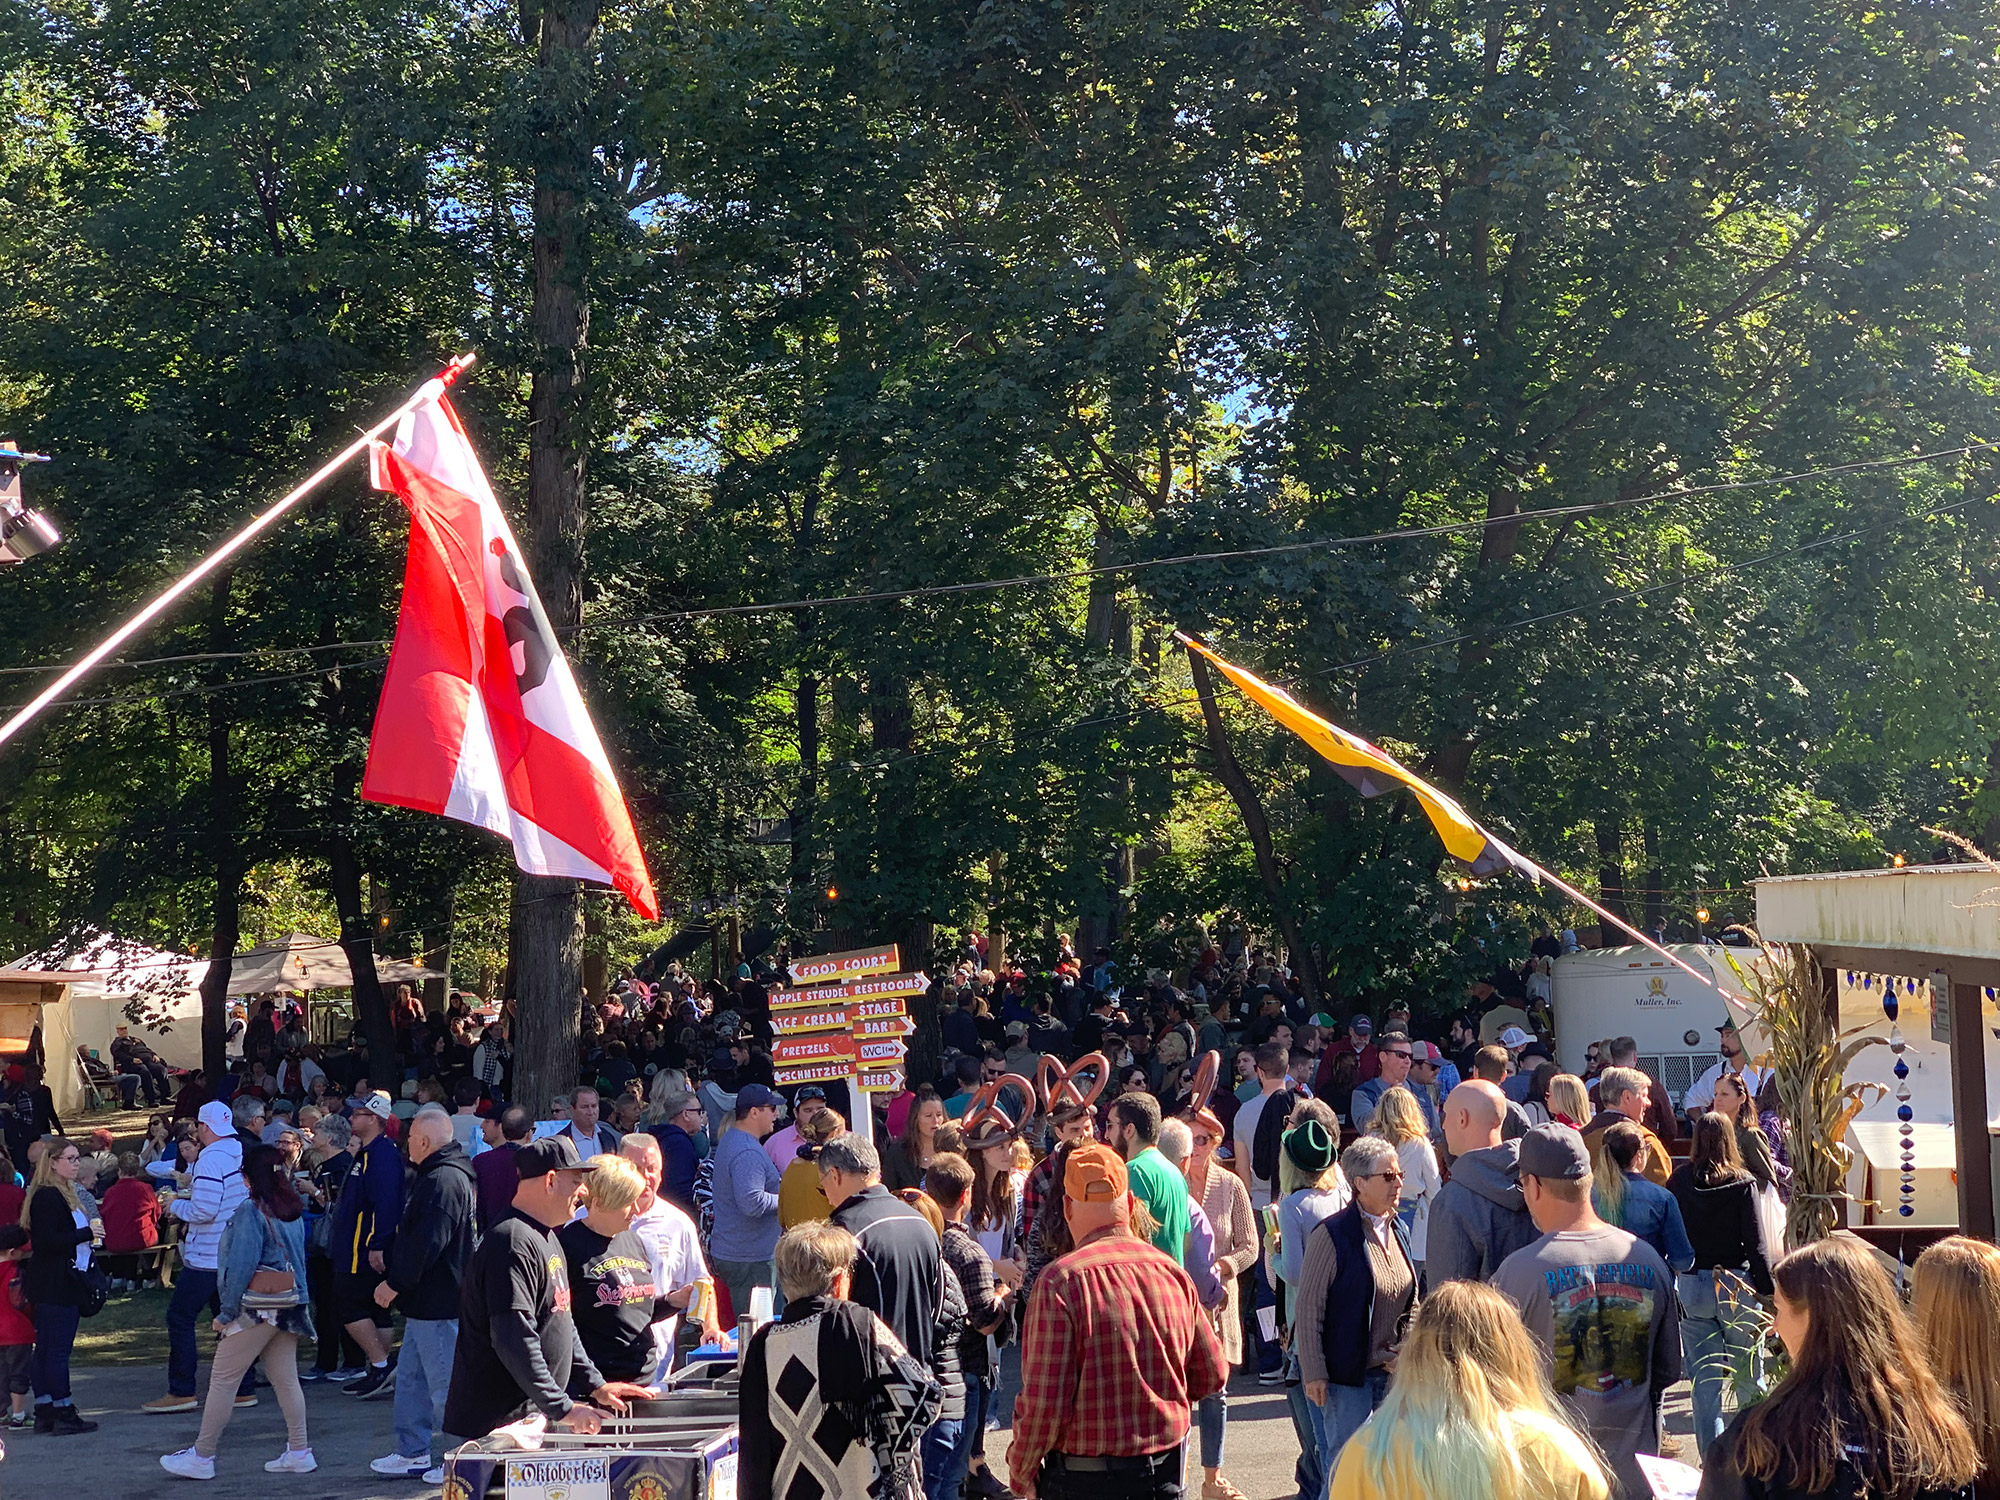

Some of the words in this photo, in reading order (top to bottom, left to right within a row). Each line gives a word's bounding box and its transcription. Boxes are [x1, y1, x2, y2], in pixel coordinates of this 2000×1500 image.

[803, 963, 837, 978] FOOD
[844, 956, 887, 971] COURT
[855, 978, 920, 995] RESTROOMS
[772, 992, 802, 1004] APPLE
[806, 987, 848, 1001] STRUDEL
[1634, 998, 1664, 1006] Muller,
[1666, 997, 1683, 1005] Inc.
[859, 1002, 897, 1015] STAGE
[804, 1013, 845, 1027] CREAM
[864, 1021, 888, 1033] BAR
[782, 1043, 829, 1057] PRETZELS
[863, 1074, 891, 1086] BEER
[371, 1100, 380, 1109] C
[522, 1460, 607, 1485] Oktoberfest
